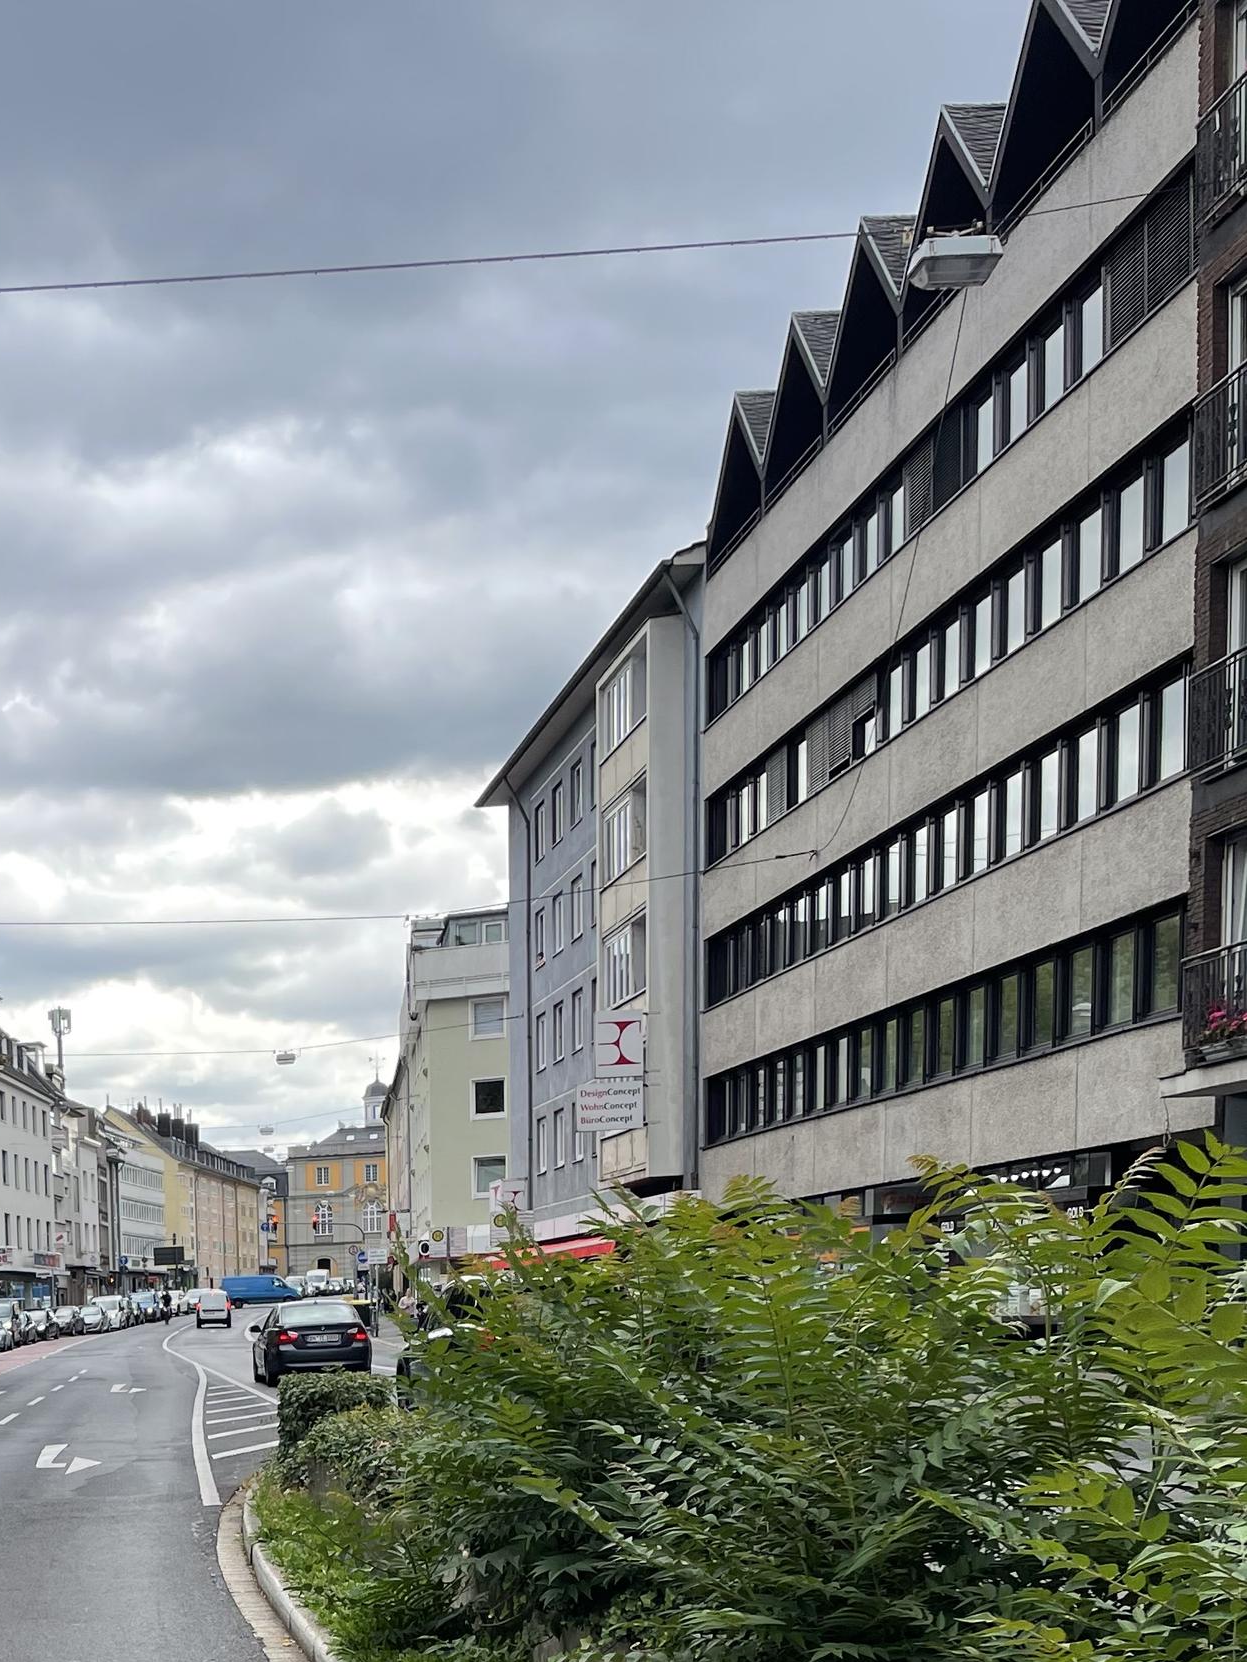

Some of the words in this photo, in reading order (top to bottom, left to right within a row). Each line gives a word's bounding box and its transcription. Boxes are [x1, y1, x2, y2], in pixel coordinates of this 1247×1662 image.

[580, 1087, 641, 1098] DesignConcept
[580, 1101, 637, 1111] WohnConcept
[580, 1115, 633, 1124] BüroConcept
